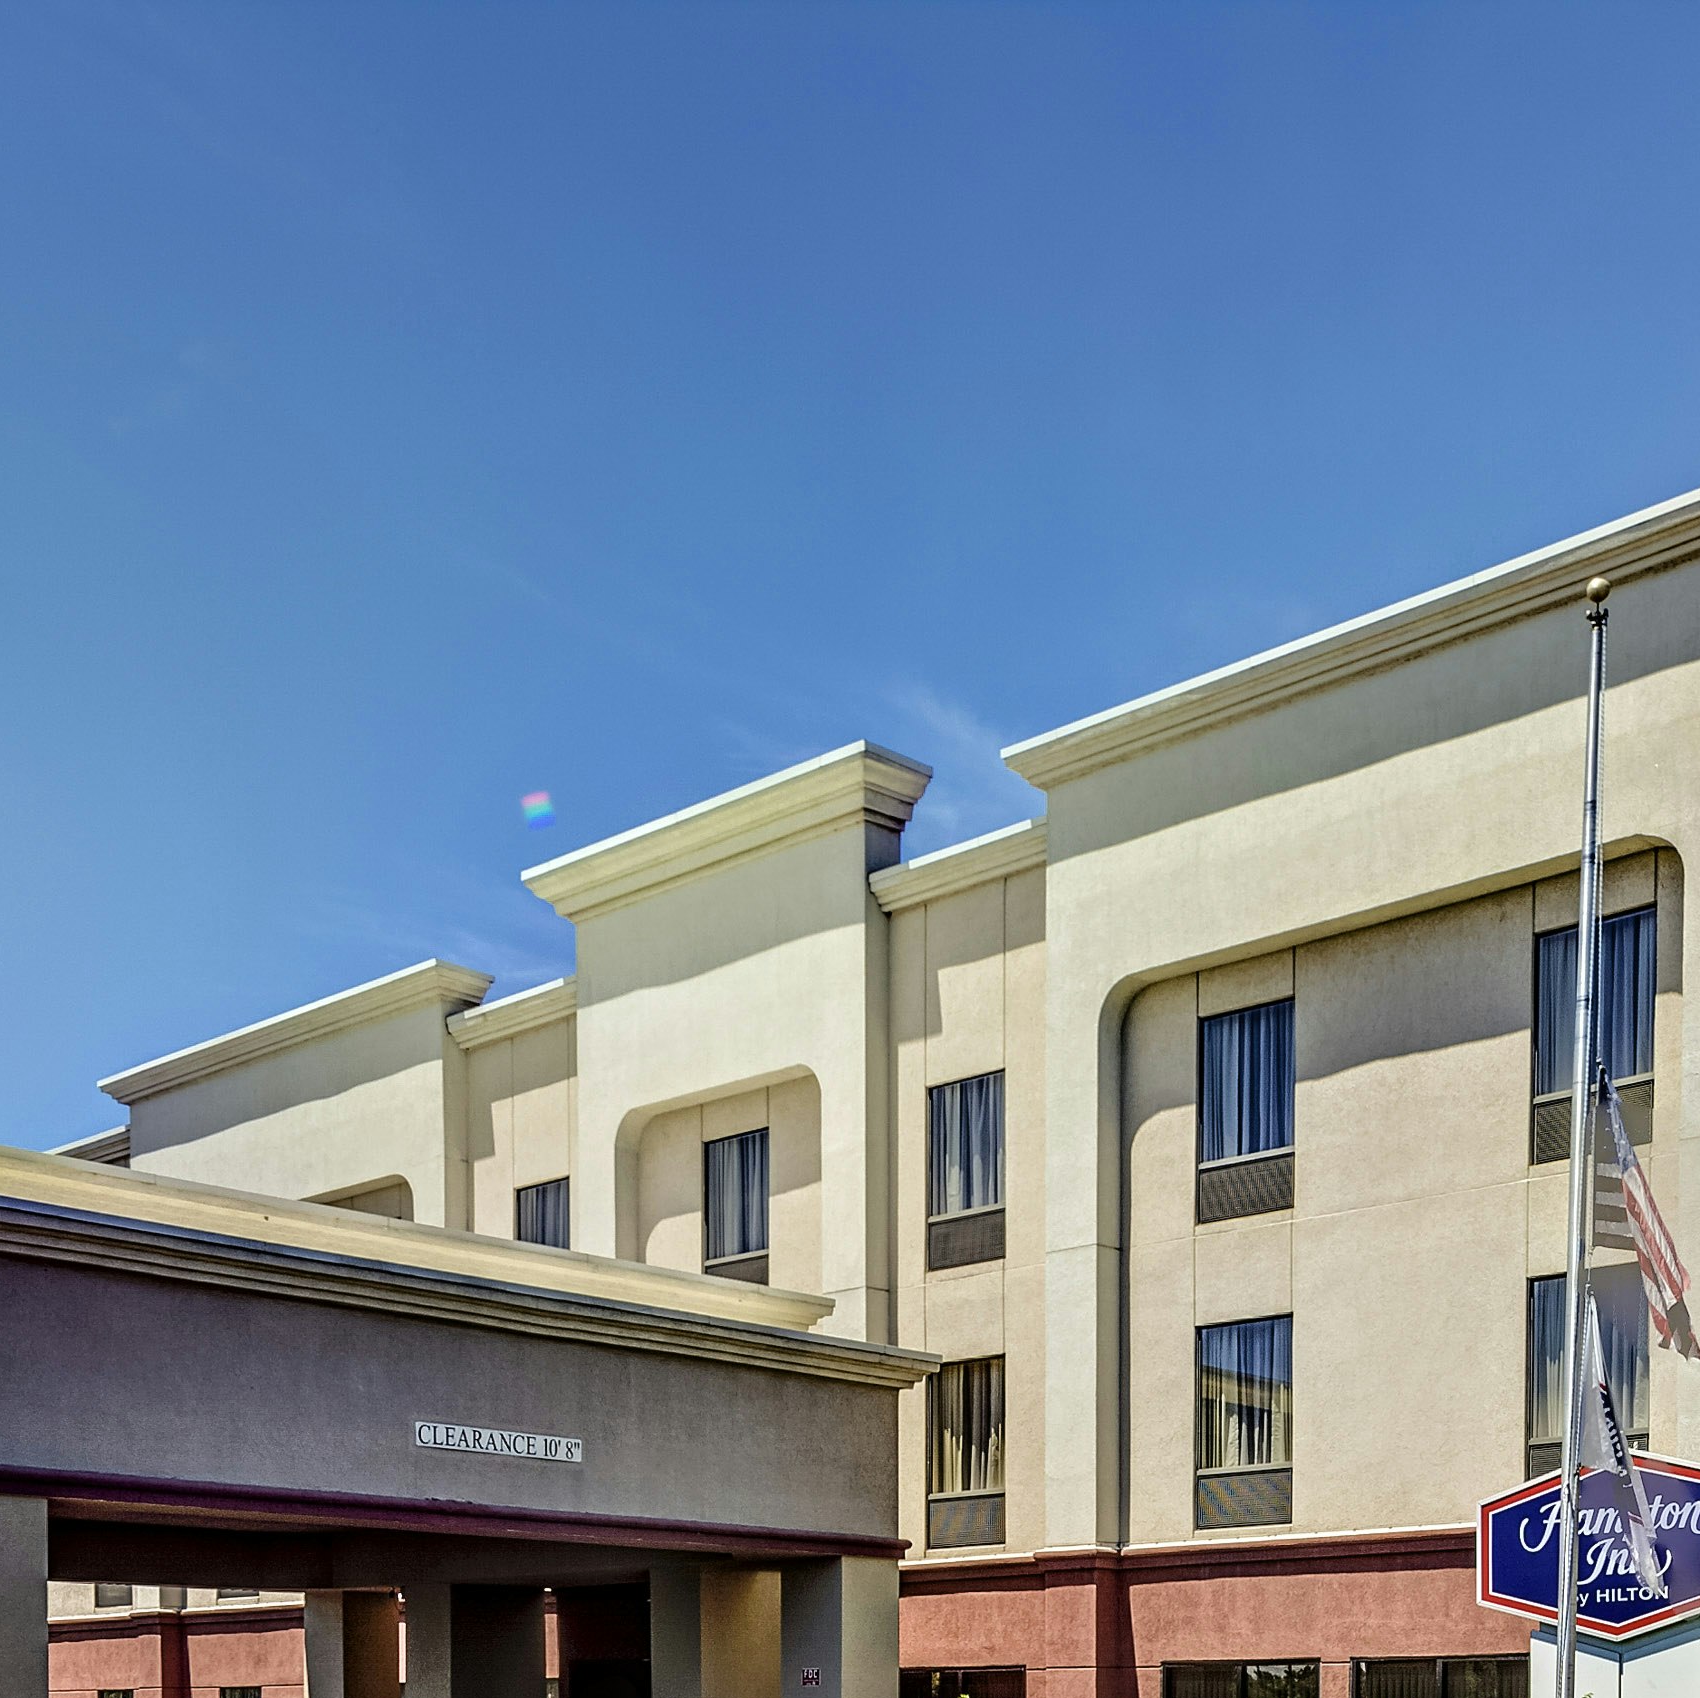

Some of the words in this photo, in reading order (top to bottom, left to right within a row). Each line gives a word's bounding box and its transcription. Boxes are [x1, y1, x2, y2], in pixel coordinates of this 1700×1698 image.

[418, 1424, 537, 1455] CLEARANCE
[543, 1438, 561, 1457] 10'
[565, 1441, 580, 1459] 8"
[1596, 1585, 1669, 1603] HILTON
